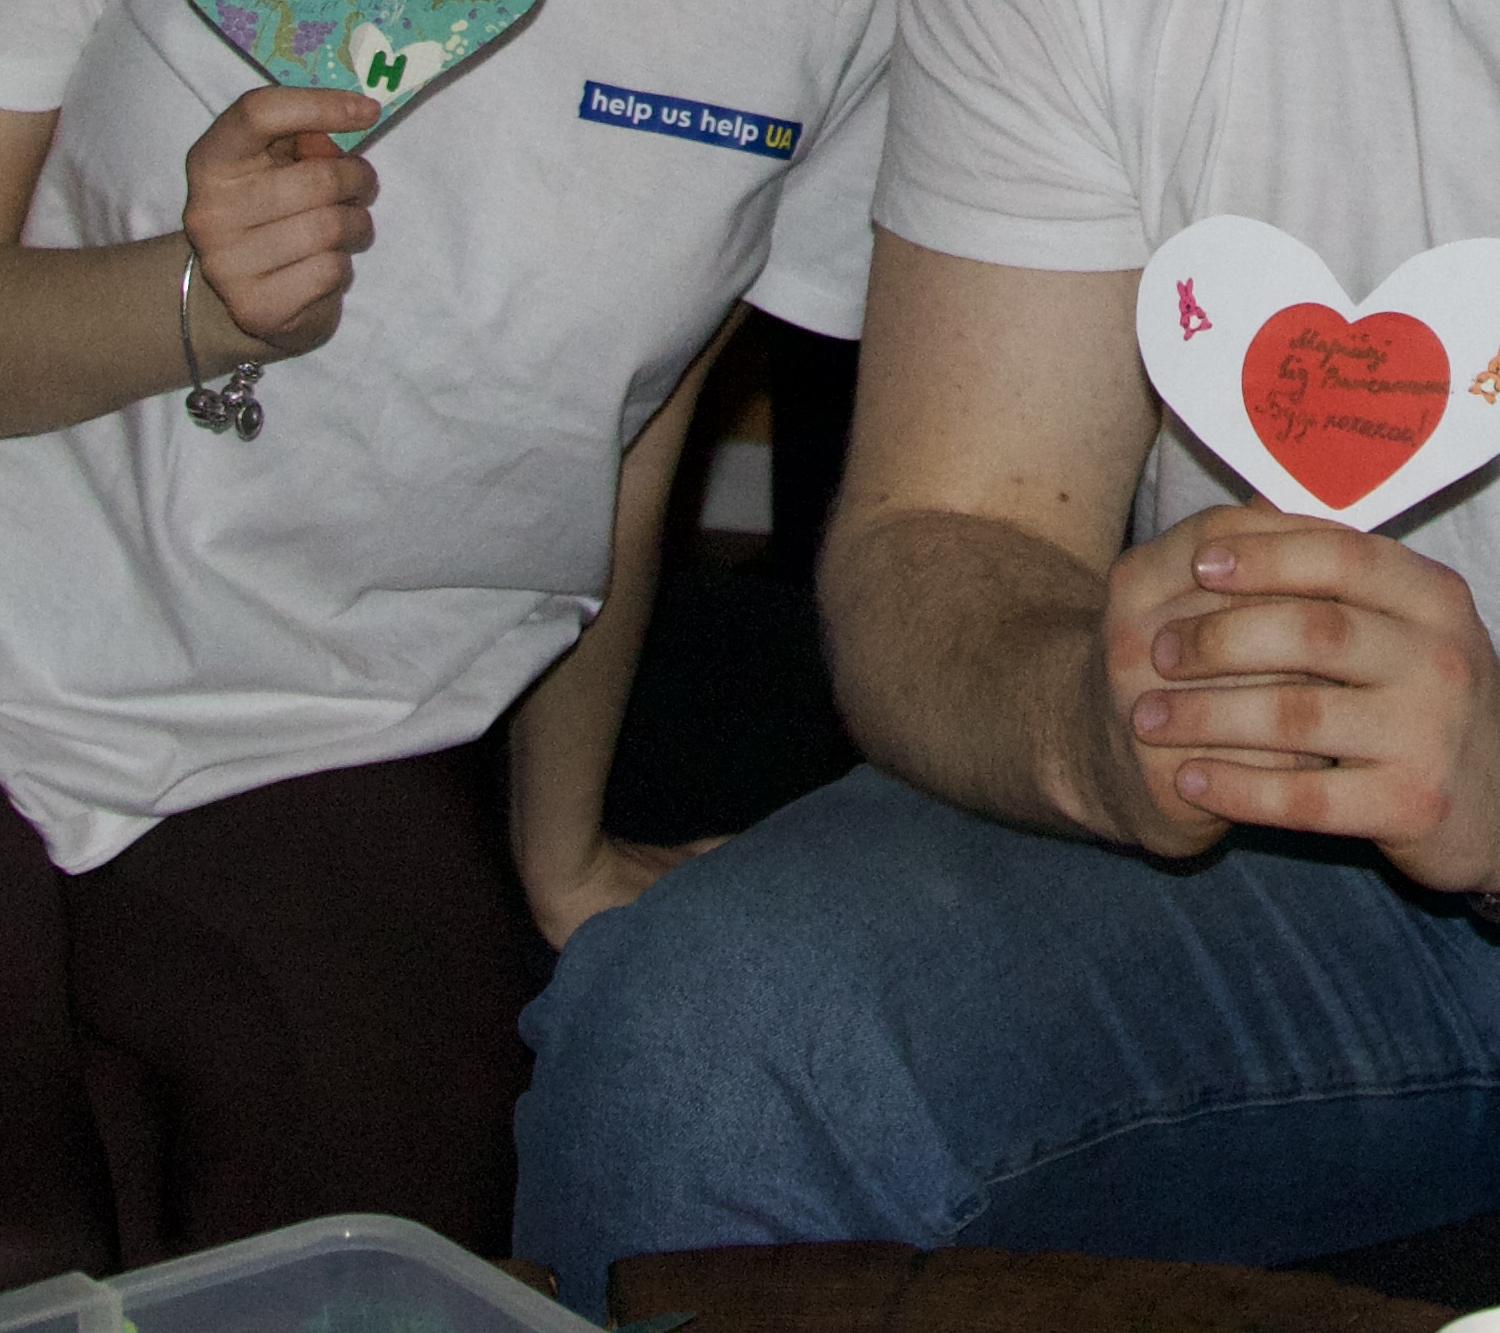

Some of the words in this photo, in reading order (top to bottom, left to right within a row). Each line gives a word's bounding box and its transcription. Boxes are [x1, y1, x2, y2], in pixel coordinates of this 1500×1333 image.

[591, 88, 652, 124] help
[661, 107, 692, 128] us
[700, 108, 759, 146] help
[765, 124, 793, 150] UA
